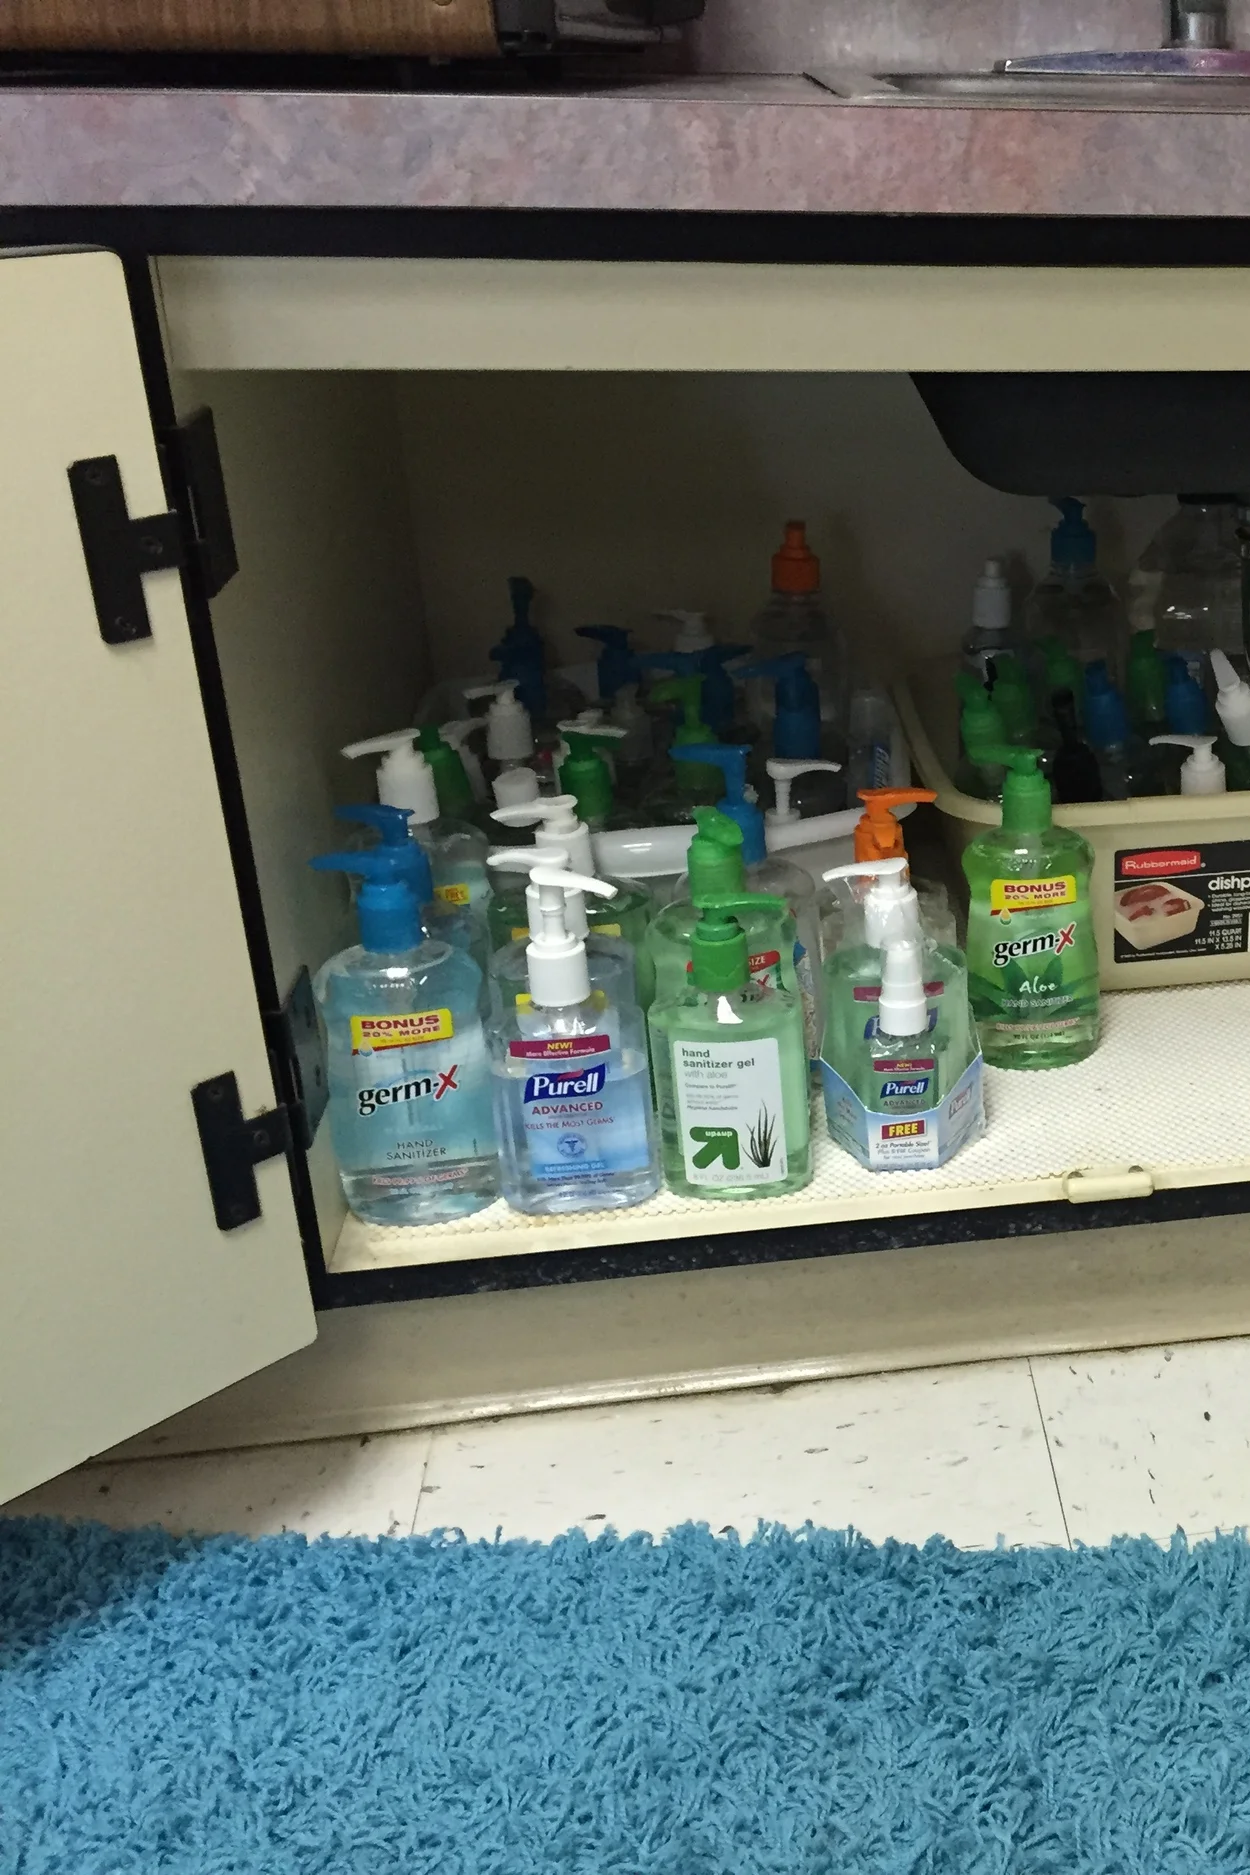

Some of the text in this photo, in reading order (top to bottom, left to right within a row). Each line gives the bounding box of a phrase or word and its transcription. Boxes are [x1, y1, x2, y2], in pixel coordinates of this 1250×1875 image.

[1125, 855, 1198, 870] Rubbermaid
[1004, 882, 1066, 893] BONUS
[1033, 891, 1066, 900] MORE
[1221, 928, 1242, 936] QUART
[1019, 976, 1058, 994] Aloe
[361, 1014, 440, 1030] BONUS
[399, 1025, 440, 1037] MORE
[547, 1042, 573, 1050] NEW!
[682, 1048, 710, 1058] hand
[683, 1058, 755, 1069] sanitizer gel
[684, 1070, 728, 1079] with aloe
[532, 1072, 599, 1096] Purell
[885, 1081, 925, 1095] Purell
[532, 1101, 604, 1115] ADVANCED
[884, 1099, 926, 1107] ADVANCED
[705, 1130, 733, 1138] up&up
[889, 1123, 918, 1137] FREE
[397, 1139, 433, 1150] HAND
[386, 1147, 447, 1161] SANITIZER
